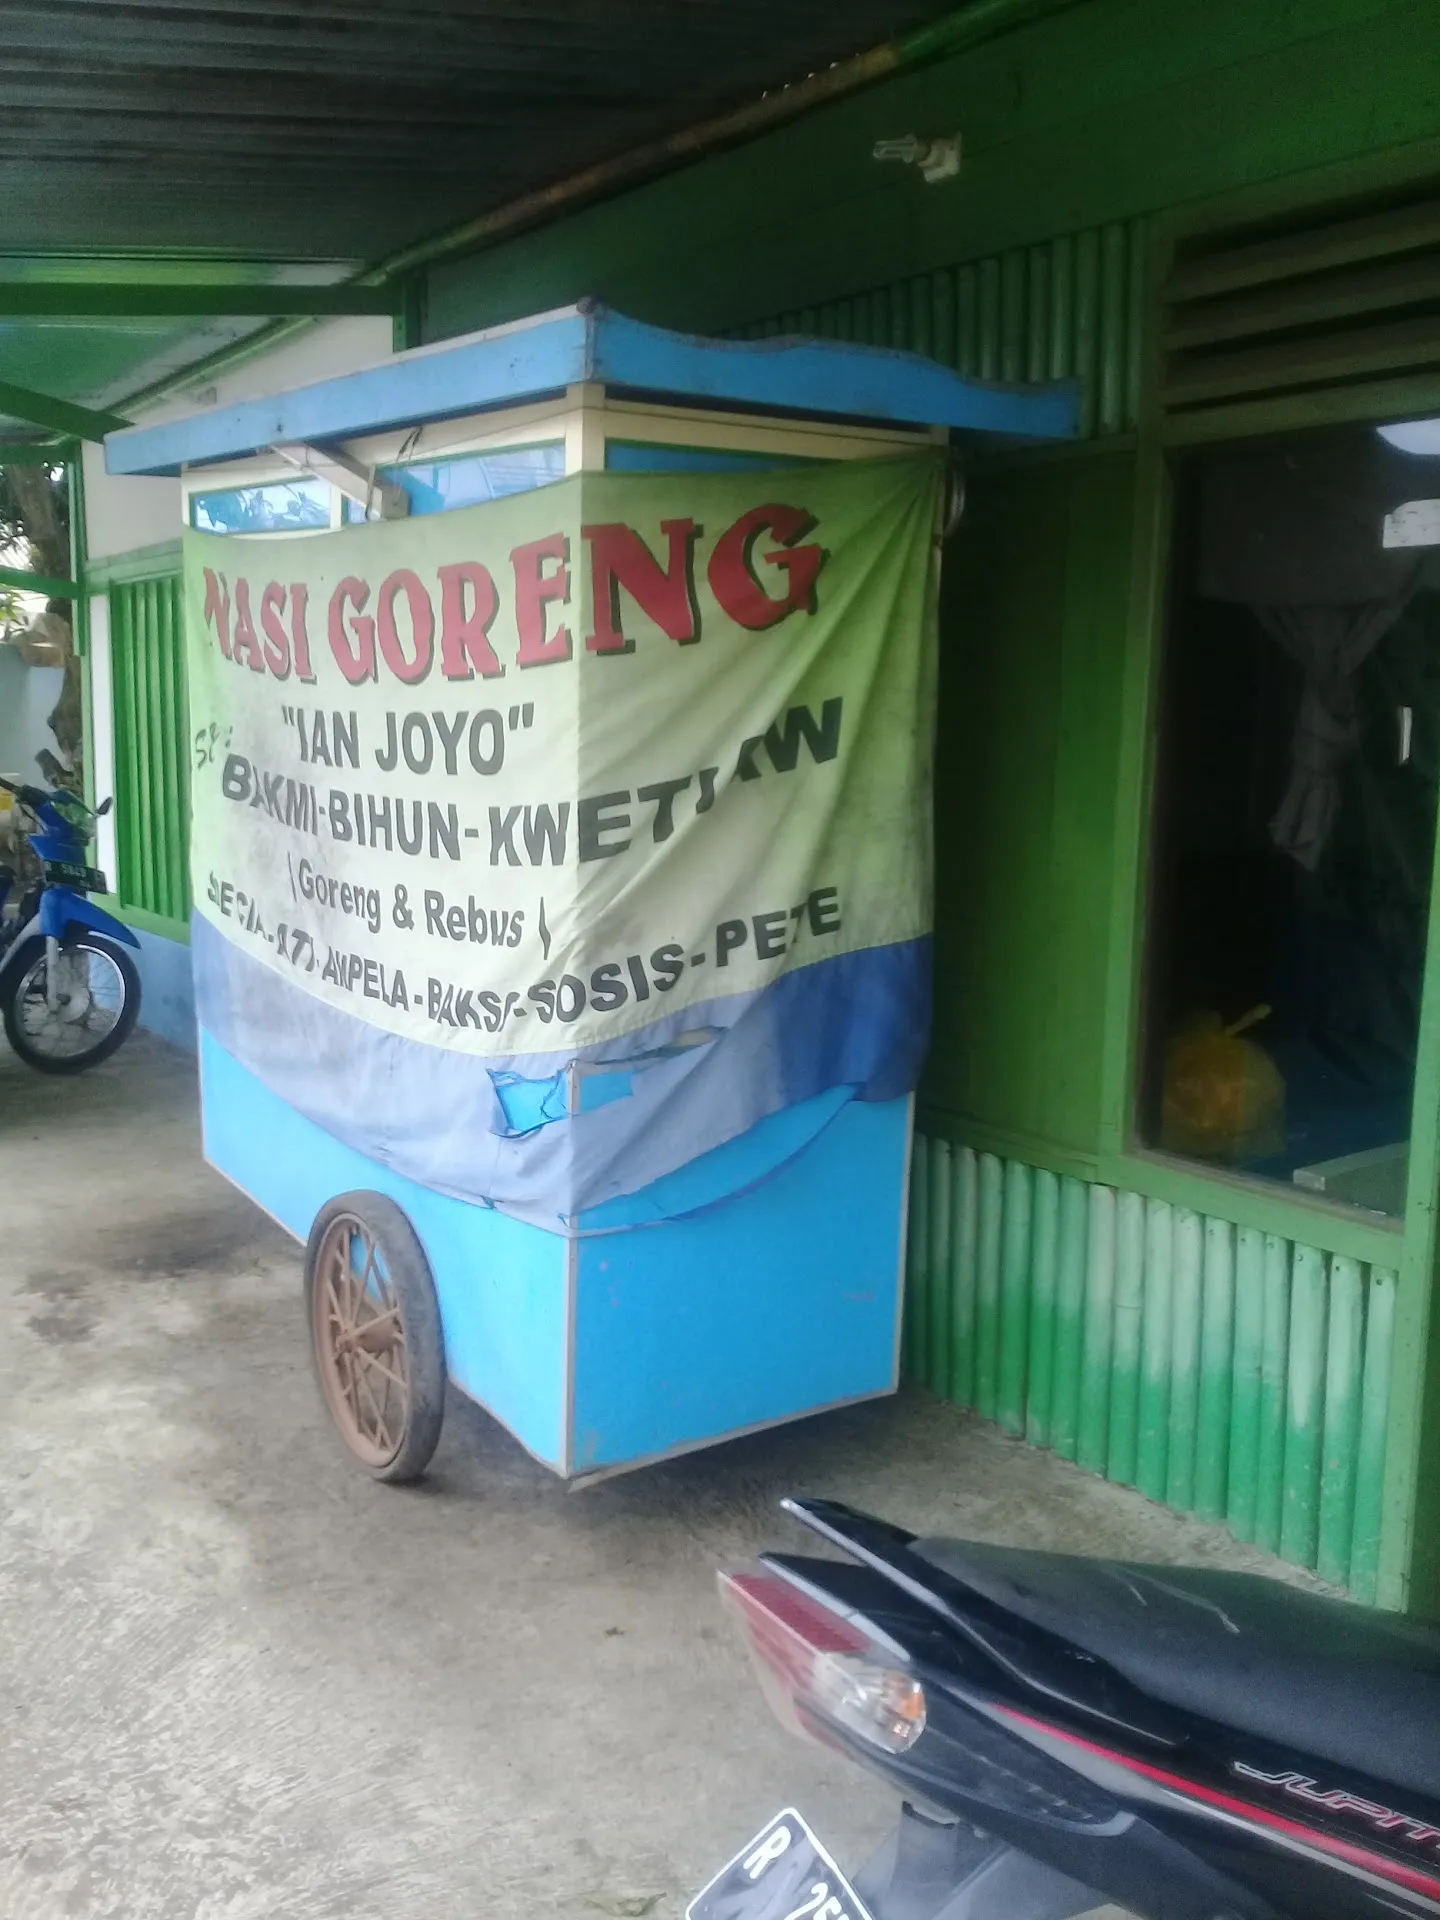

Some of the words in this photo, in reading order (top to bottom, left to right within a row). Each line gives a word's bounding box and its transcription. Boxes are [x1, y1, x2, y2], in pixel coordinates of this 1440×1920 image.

[203, 567, 317, 684] NASI
[328, 503, 830, 684] GORENG
[375, 702, 534, 776] JOYO"
[392, 884, 415, 931] &
[743, 1826, 791, 1880] R
